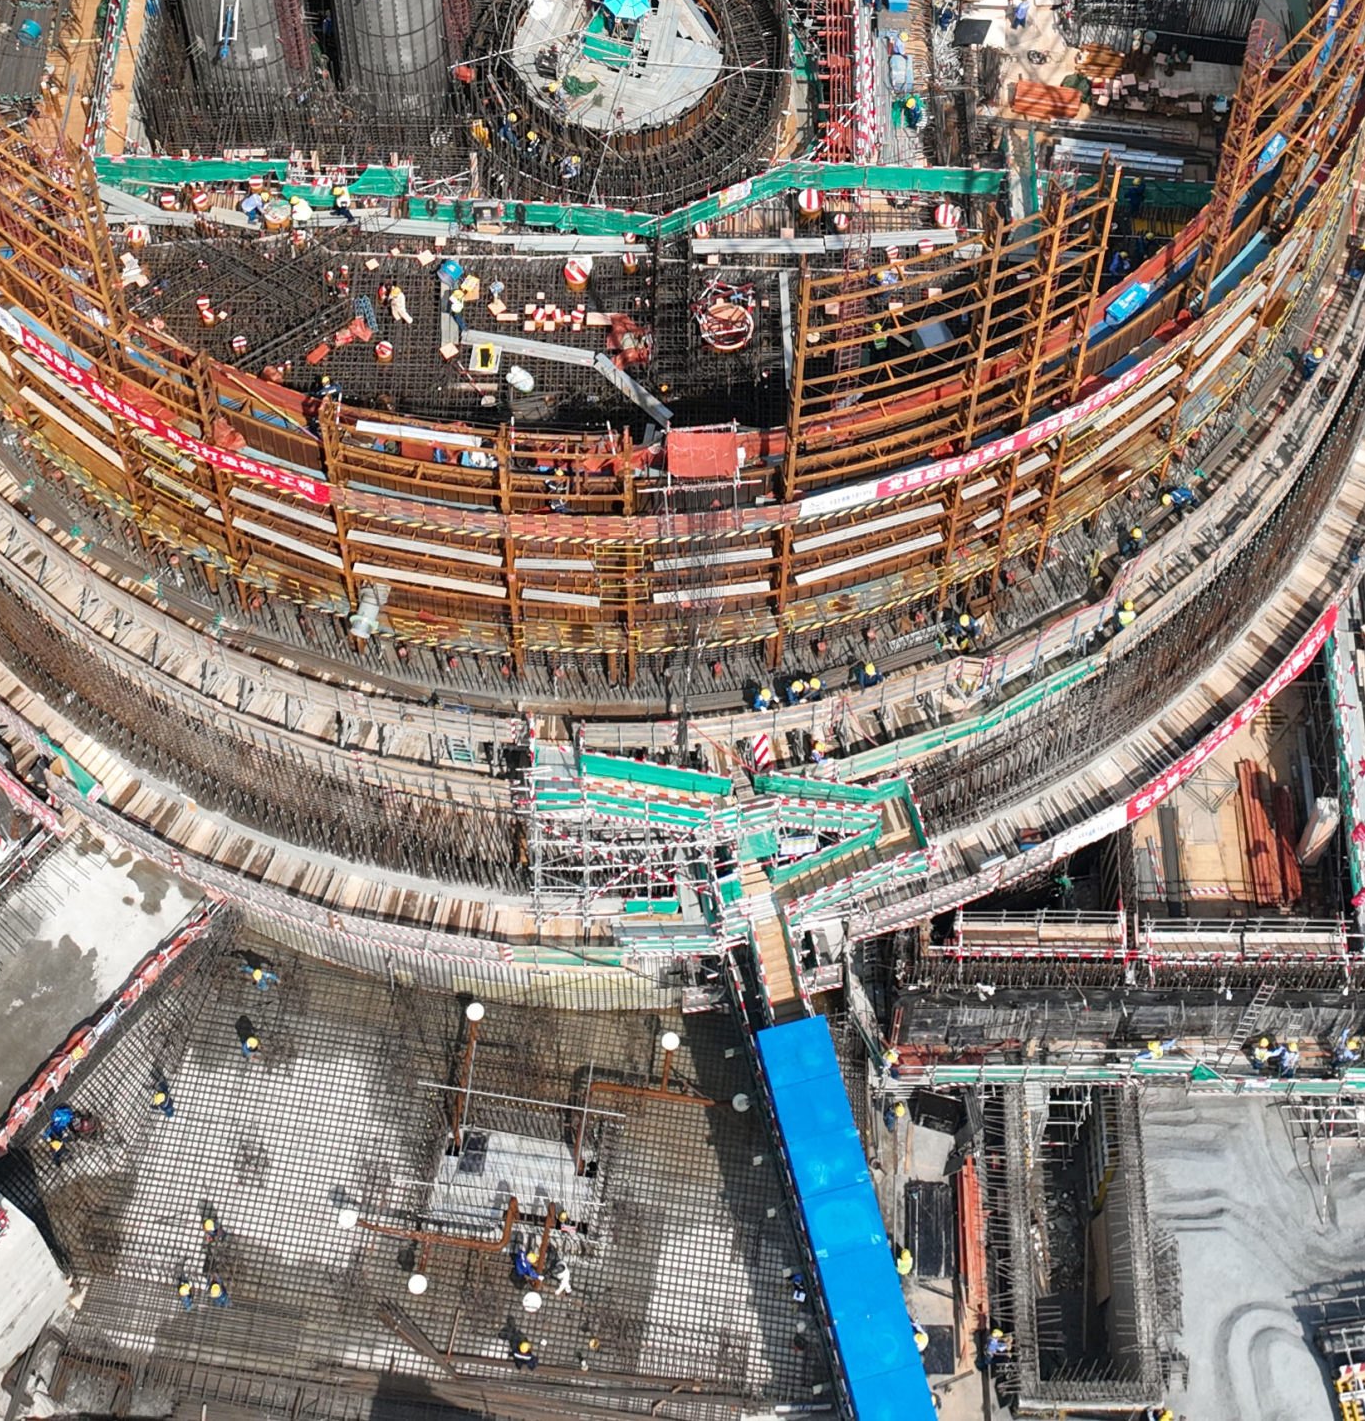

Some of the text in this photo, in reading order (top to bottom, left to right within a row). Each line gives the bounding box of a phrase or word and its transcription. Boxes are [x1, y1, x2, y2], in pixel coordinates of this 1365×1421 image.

[167, 430, 315, 493] 助力打造标杆工程
